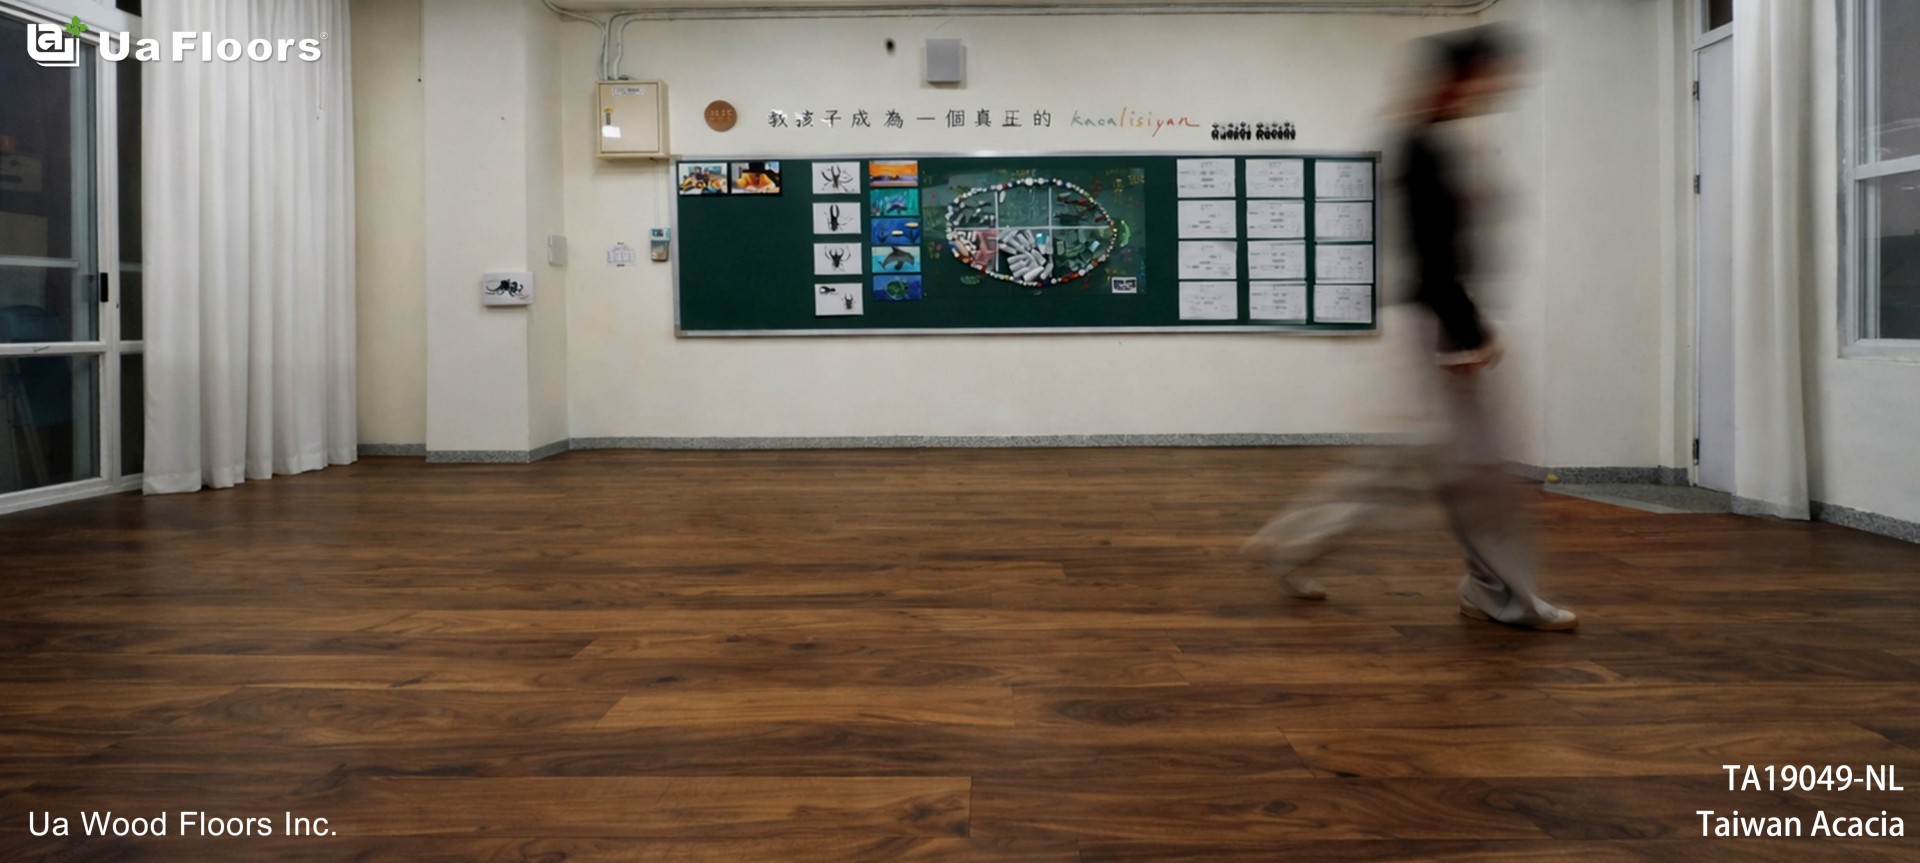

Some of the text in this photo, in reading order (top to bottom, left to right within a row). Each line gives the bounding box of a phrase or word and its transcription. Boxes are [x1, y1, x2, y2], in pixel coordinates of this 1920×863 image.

[768, 108, 1052, 129] 教孩子成為一個真正的
